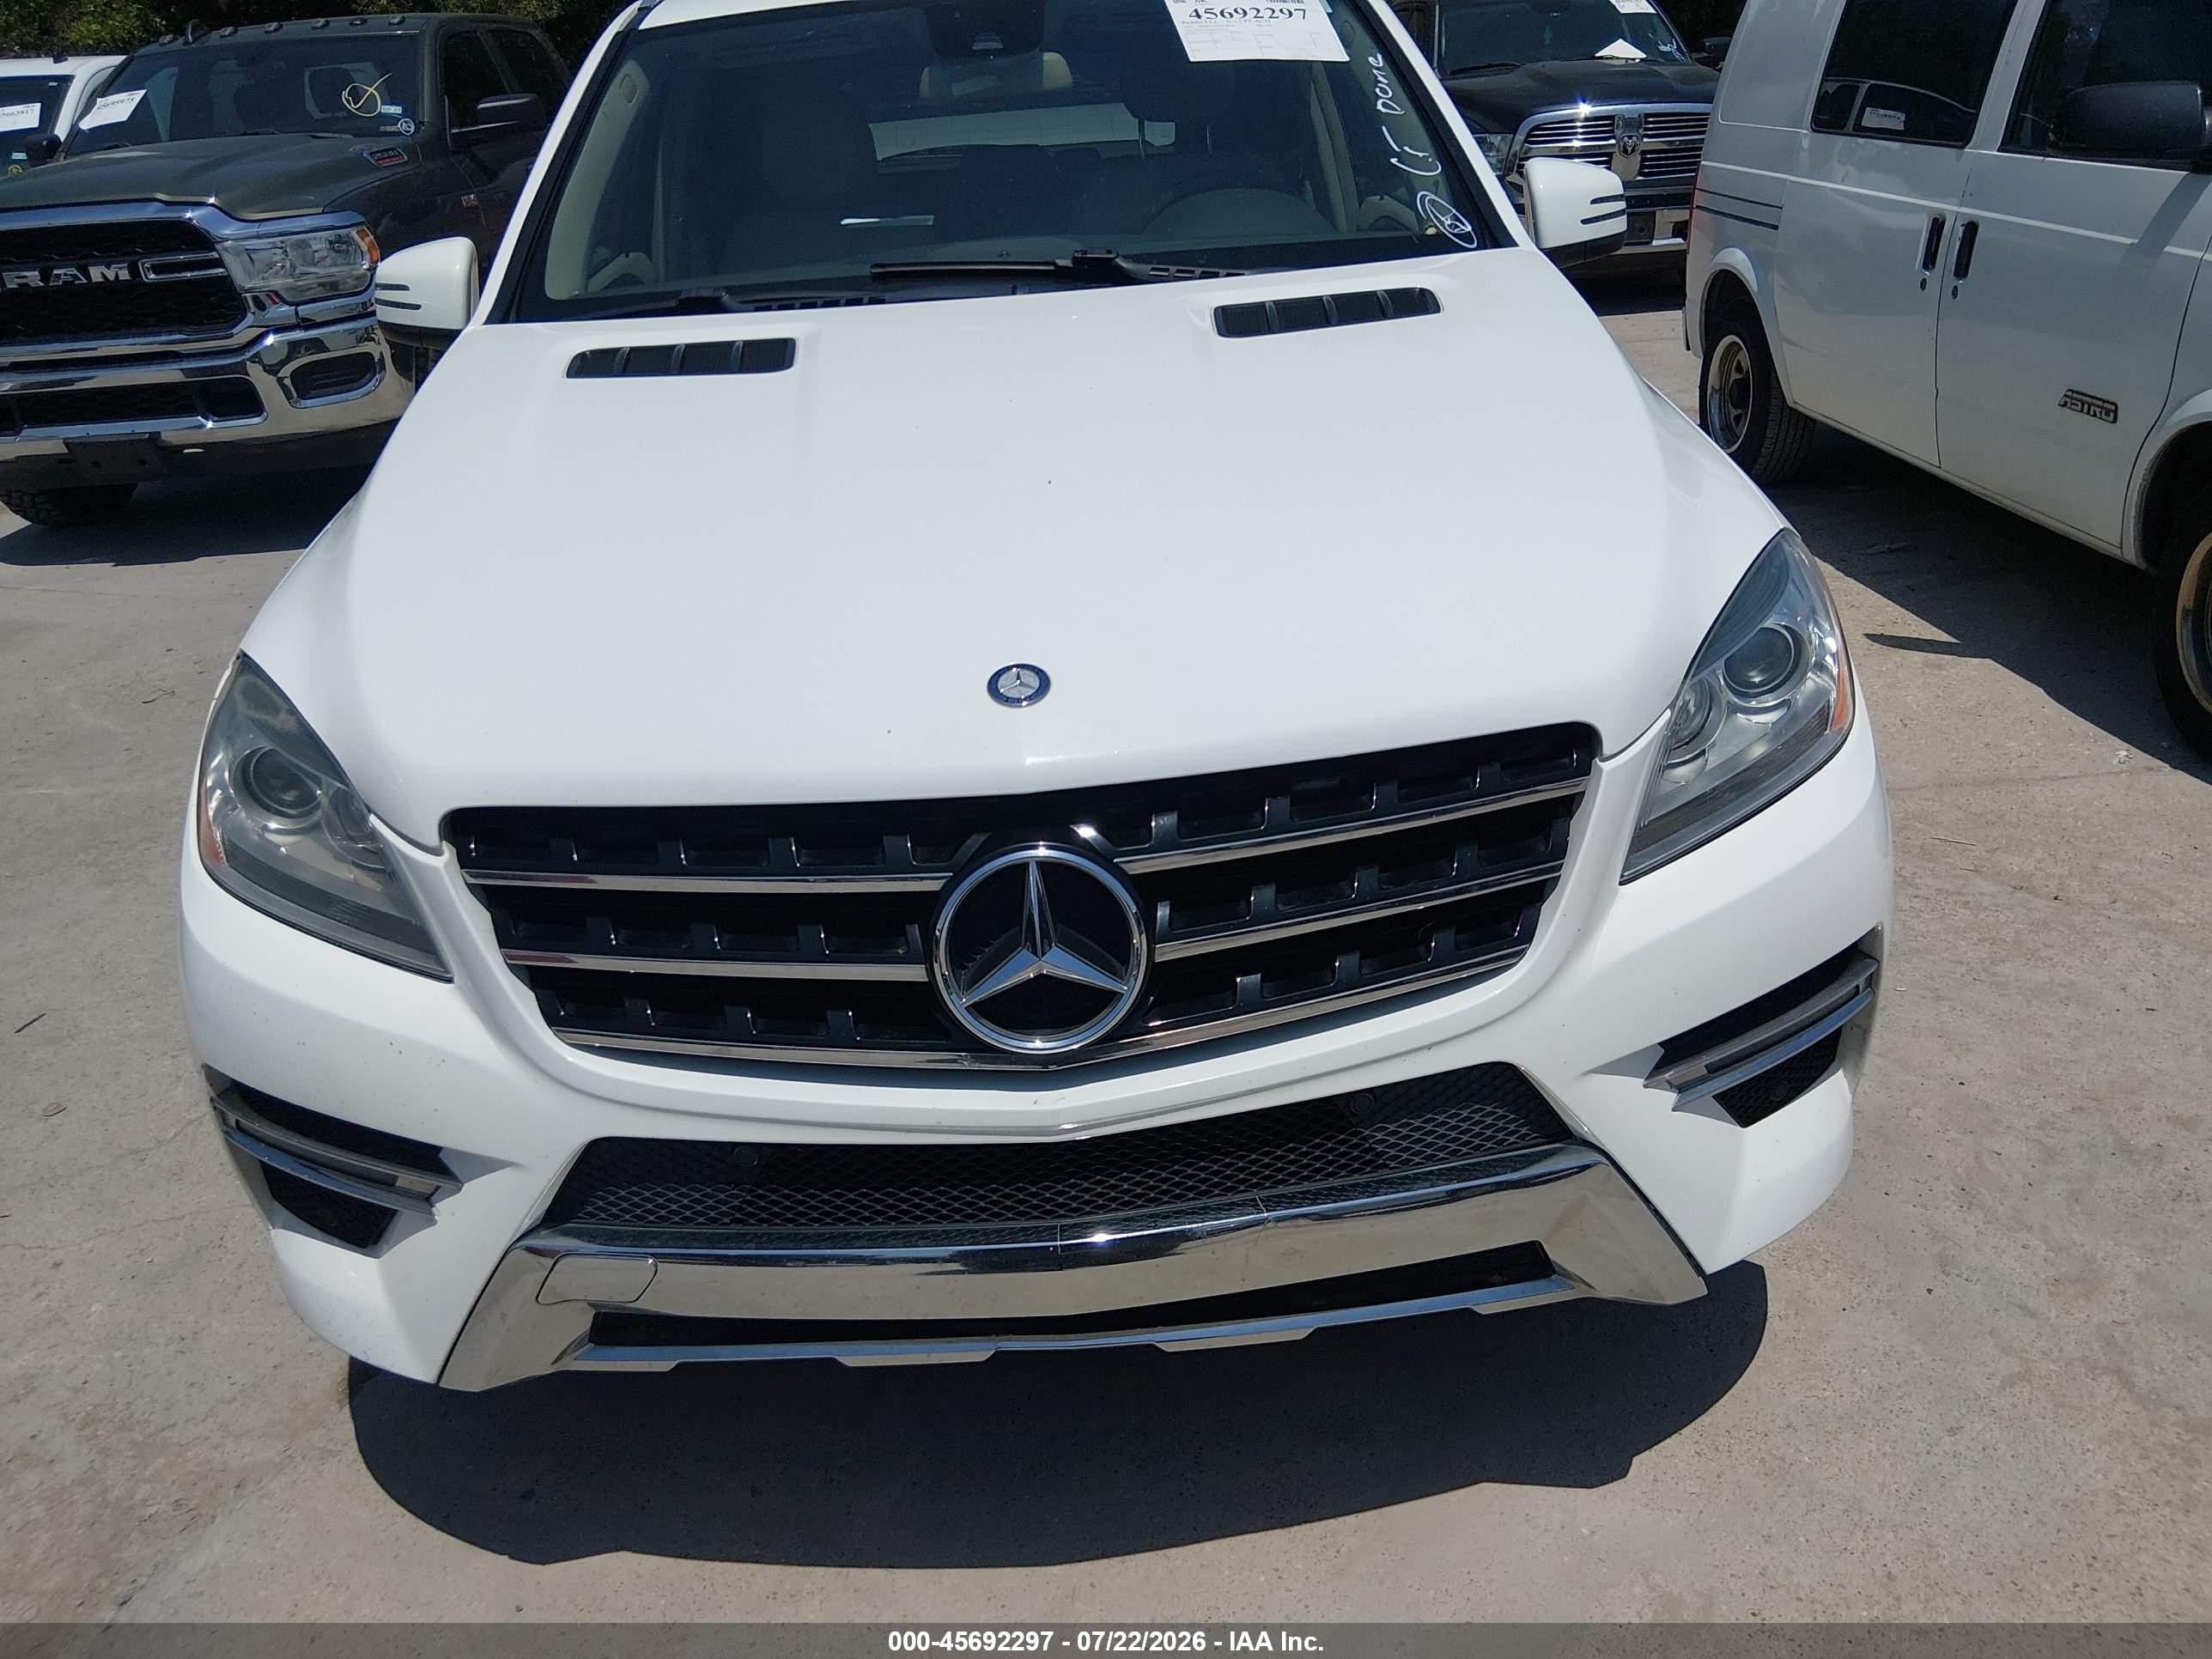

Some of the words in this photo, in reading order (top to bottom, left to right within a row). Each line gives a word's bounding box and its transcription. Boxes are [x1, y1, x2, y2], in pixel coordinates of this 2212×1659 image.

[1188, 7, 1306, 21] 45692297
[2, 263, 131, 289] RAM
[2058, 391, 2117, 422] ASTRO
